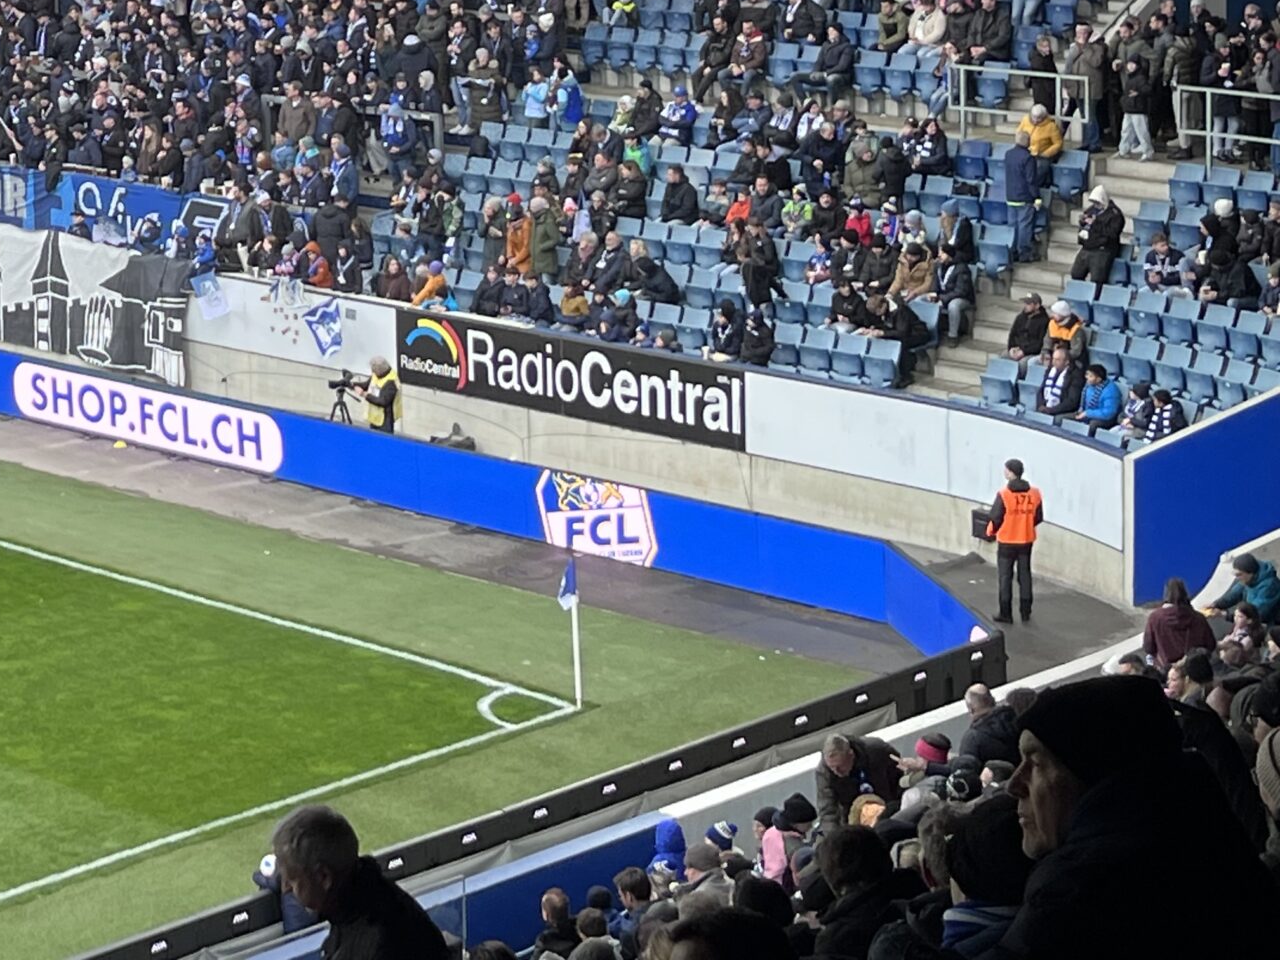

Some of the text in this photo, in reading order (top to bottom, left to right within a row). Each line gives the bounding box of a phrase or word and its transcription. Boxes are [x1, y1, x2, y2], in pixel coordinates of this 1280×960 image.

[400, 353, 460, 379] RadioCentral
[466, 328, 742, 436] RadioCentral
[31, 371, 263, 462] SHOP.FCL.CH
[565, 512, 640, 549] FCL
